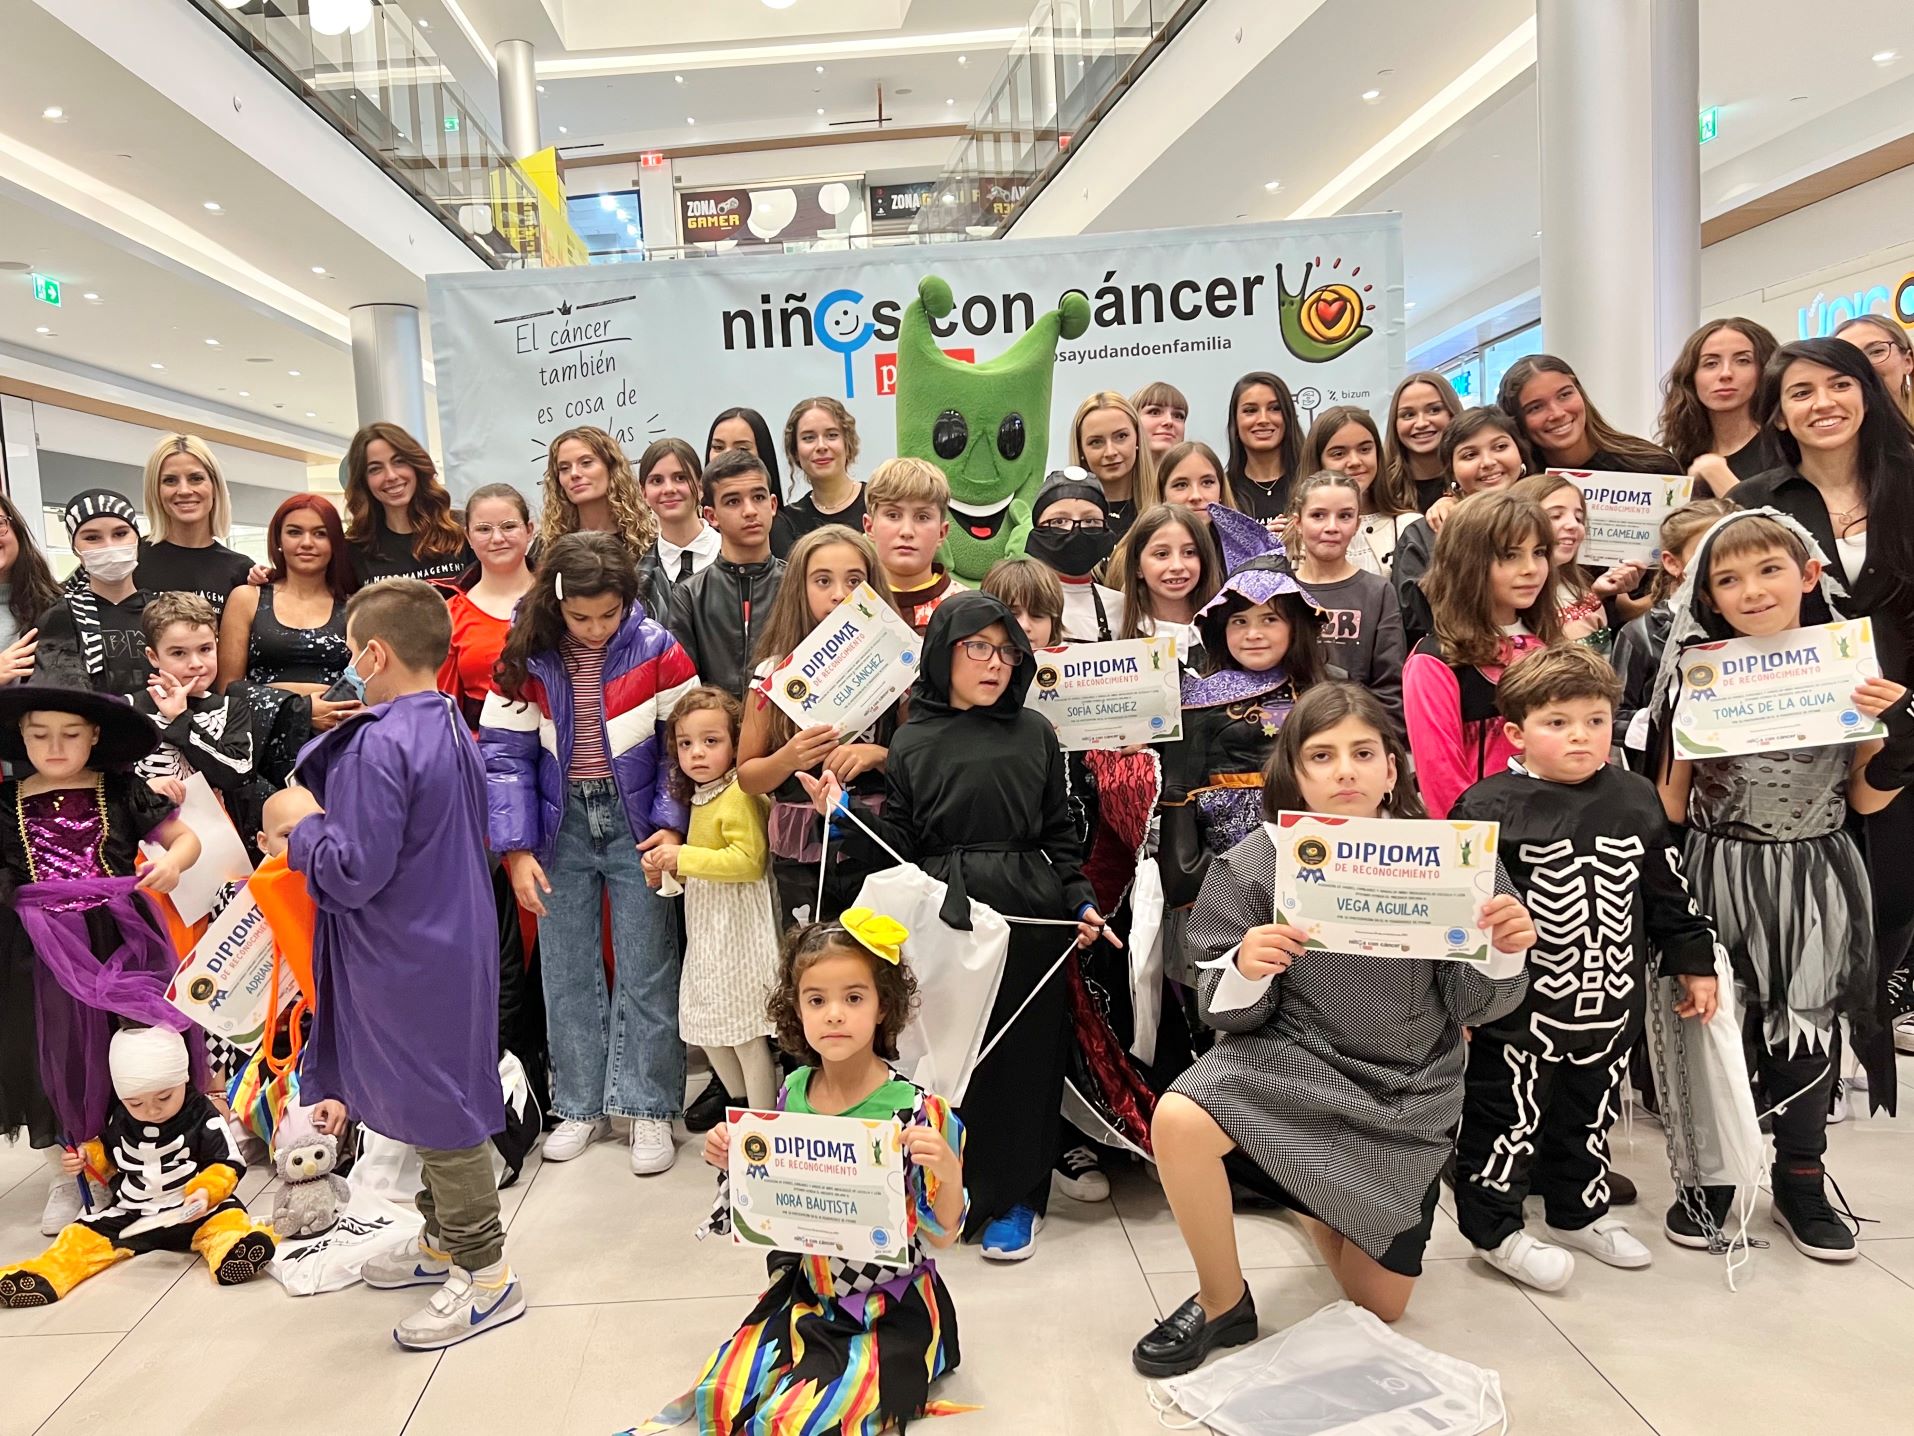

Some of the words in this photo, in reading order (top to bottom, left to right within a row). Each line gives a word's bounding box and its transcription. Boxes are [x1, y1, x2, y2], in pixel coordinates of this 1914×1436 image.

[687, 199, 717, 217] ZONA
[891, 193, 921, 210] ZONA
[687, 214, 740, 229] GAMER
[516, 323, 540, 356] El
[550, 319, 612, 351] cáncer
[540, 352, 617, 387] también
[537, 405, 554, 426] es
[565, 392, 605, 420] cosa
[616, 379, 637, 408] de
[1341, 389, 1371, 399] bizum
[1583, 488, 1653, 506] DIPLOMA
[1591, 503, 1651, 515] RECONOCIMIENTO
[1606, 528, 1650, 541] CAMELINO
[801, 620, 860, 679] DIPLOMA
[813, 676, 823, 688] DE
[822, 632, 866, 680] RECONOCIMIENTO
[1064, 656, 1139, 679] DIPLOMA
[1722, 646, 1820, 676] DIPLOMA
[1064, 681, 1074, 689] DE
[1076, 675, 1139, 688] RECONOCIMIENTO
[1722, 678, 1736, 687] DE
[1738, 666, 1822, 685] RECONOCIMIENTO
[833, 684, 857, 708] CELIA
[1713, 701, 1755, 721] TOMÁS
[1758, 702, 1775, 714] DE
[1778, 697, 1796, 711] LA
[1800, 691, 1836, 708] OLIVA
[1095, 700, 1138, 716] SÁNCHEZ
[1337, 841, 1441, 867] DIPLOMA
[1334, 862, 1348, 873] DE
[1352, 865, 1441, 880] RECONOCIMIENTO
[1336, 896, 1371, 913] VEGA
[1375, 899, 1429, 917] AGUILAR
[220, 968, 232, 981] DE
[774, 1136, 857, 1164] DIPLOMA
[775, 1158, 786, 1168] DE
[788, 1160, 858, 1177] RECONOCIMIENTO
[775, 1192, 803, 1208] NORA
[806, 1196, 858, 1216] BAUTISTA
